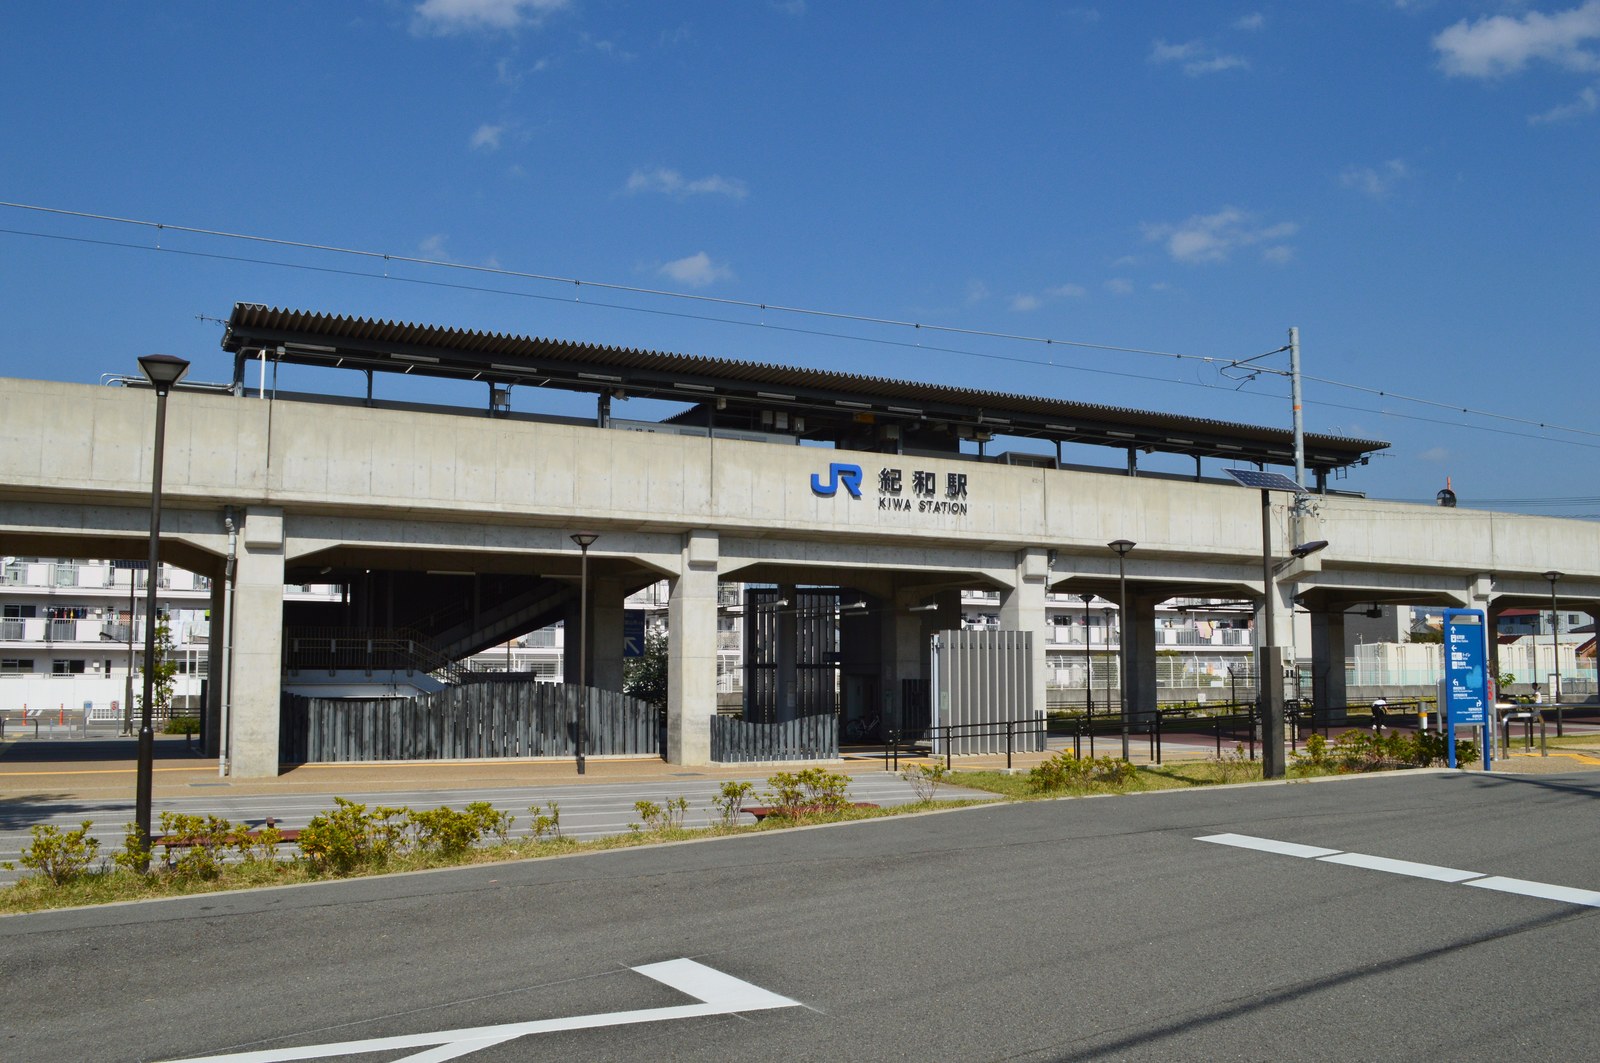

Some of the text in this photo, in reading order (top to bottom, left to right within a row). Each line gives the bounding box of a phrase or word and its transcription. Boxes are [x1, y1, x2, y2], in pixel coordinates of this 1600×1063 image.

[811, 463, 862, 496] JR
[879, 468, 967, 497] 紀和駅
[879, 497, 967, 513] KIWA STATION
